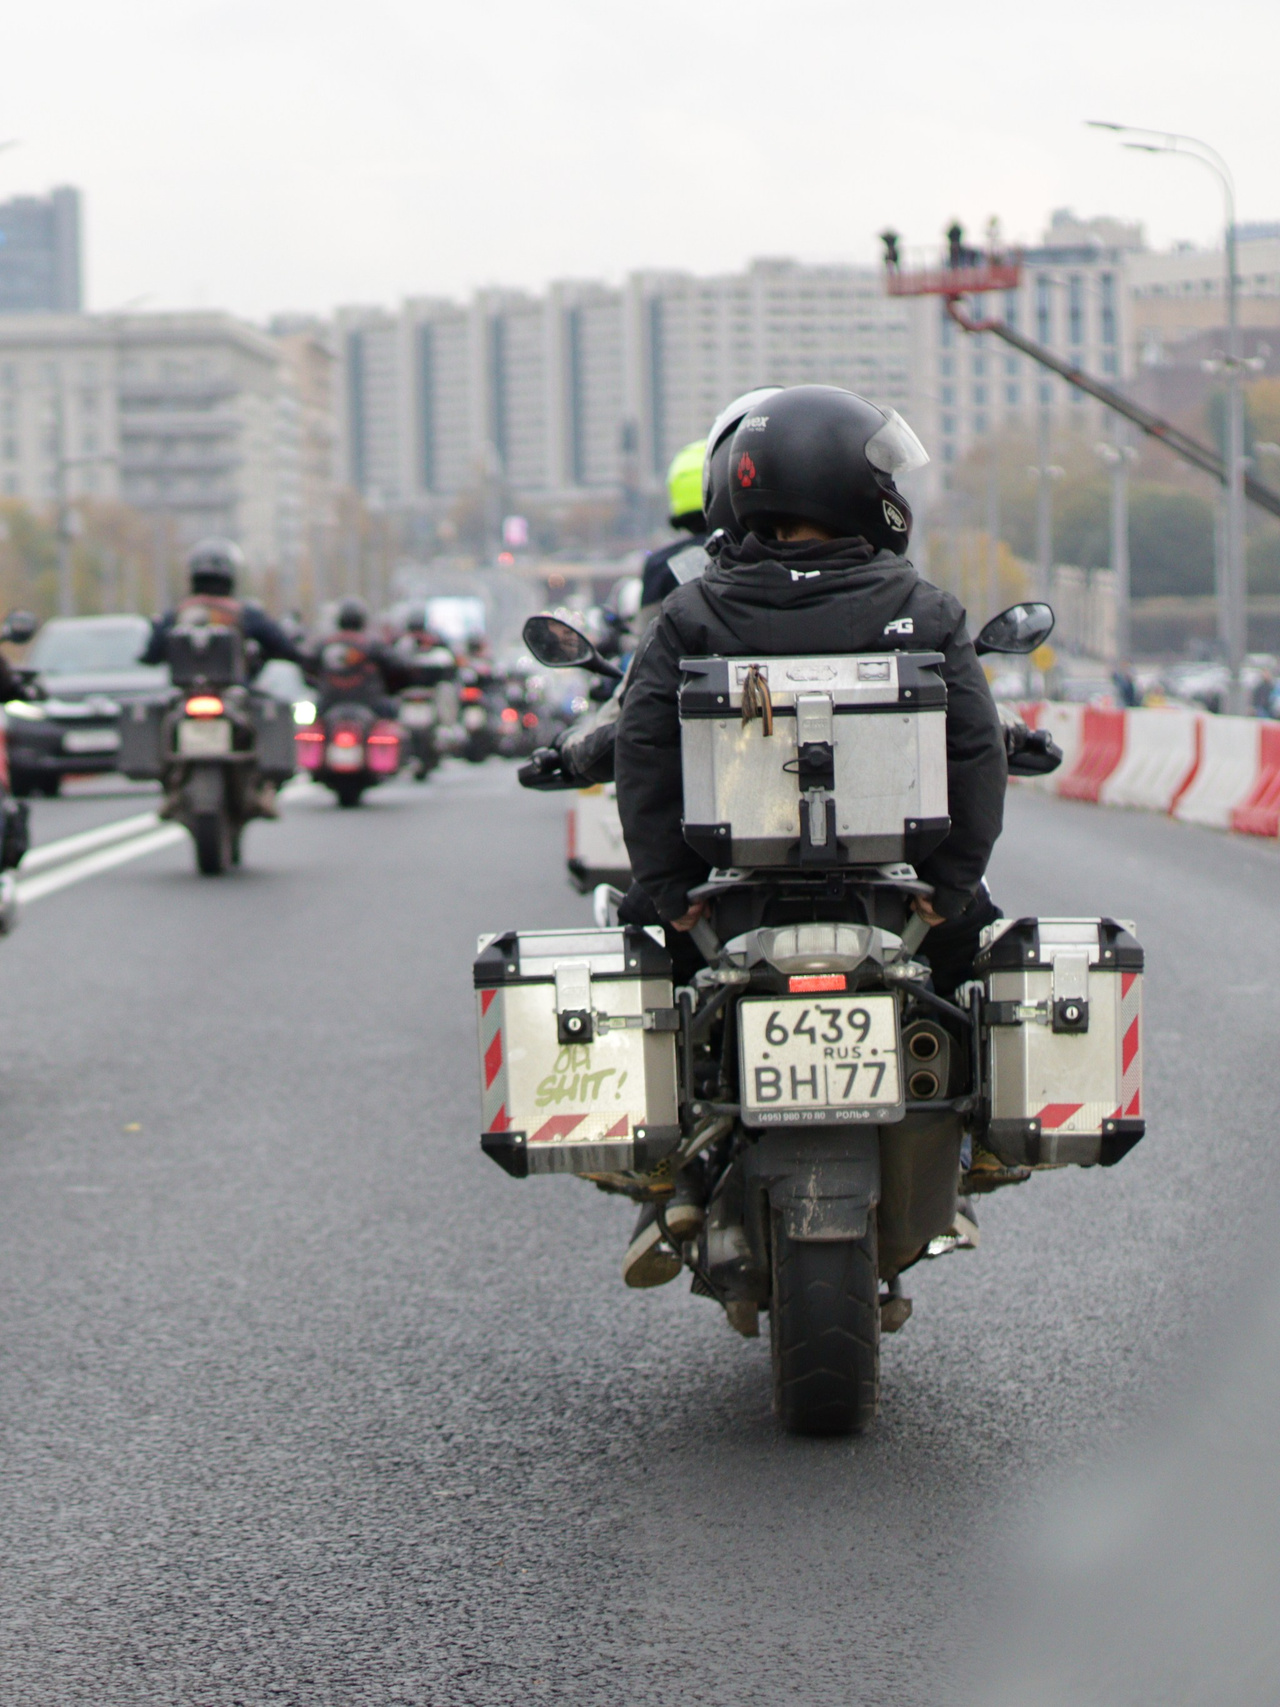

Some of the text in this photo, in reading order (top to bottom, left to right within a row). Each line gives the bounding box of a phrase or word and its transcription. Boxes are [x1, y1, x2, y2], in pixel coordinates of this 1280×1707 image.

[764, 1007, 872, 1046] 6439
[823, 1046, 862, 1060] RUS
[535, 1067, 628, 1107] SHIT!
[834, 1061, 887, 1100] 77
[835, 1110, 870, 1119] РОЛЬФ
